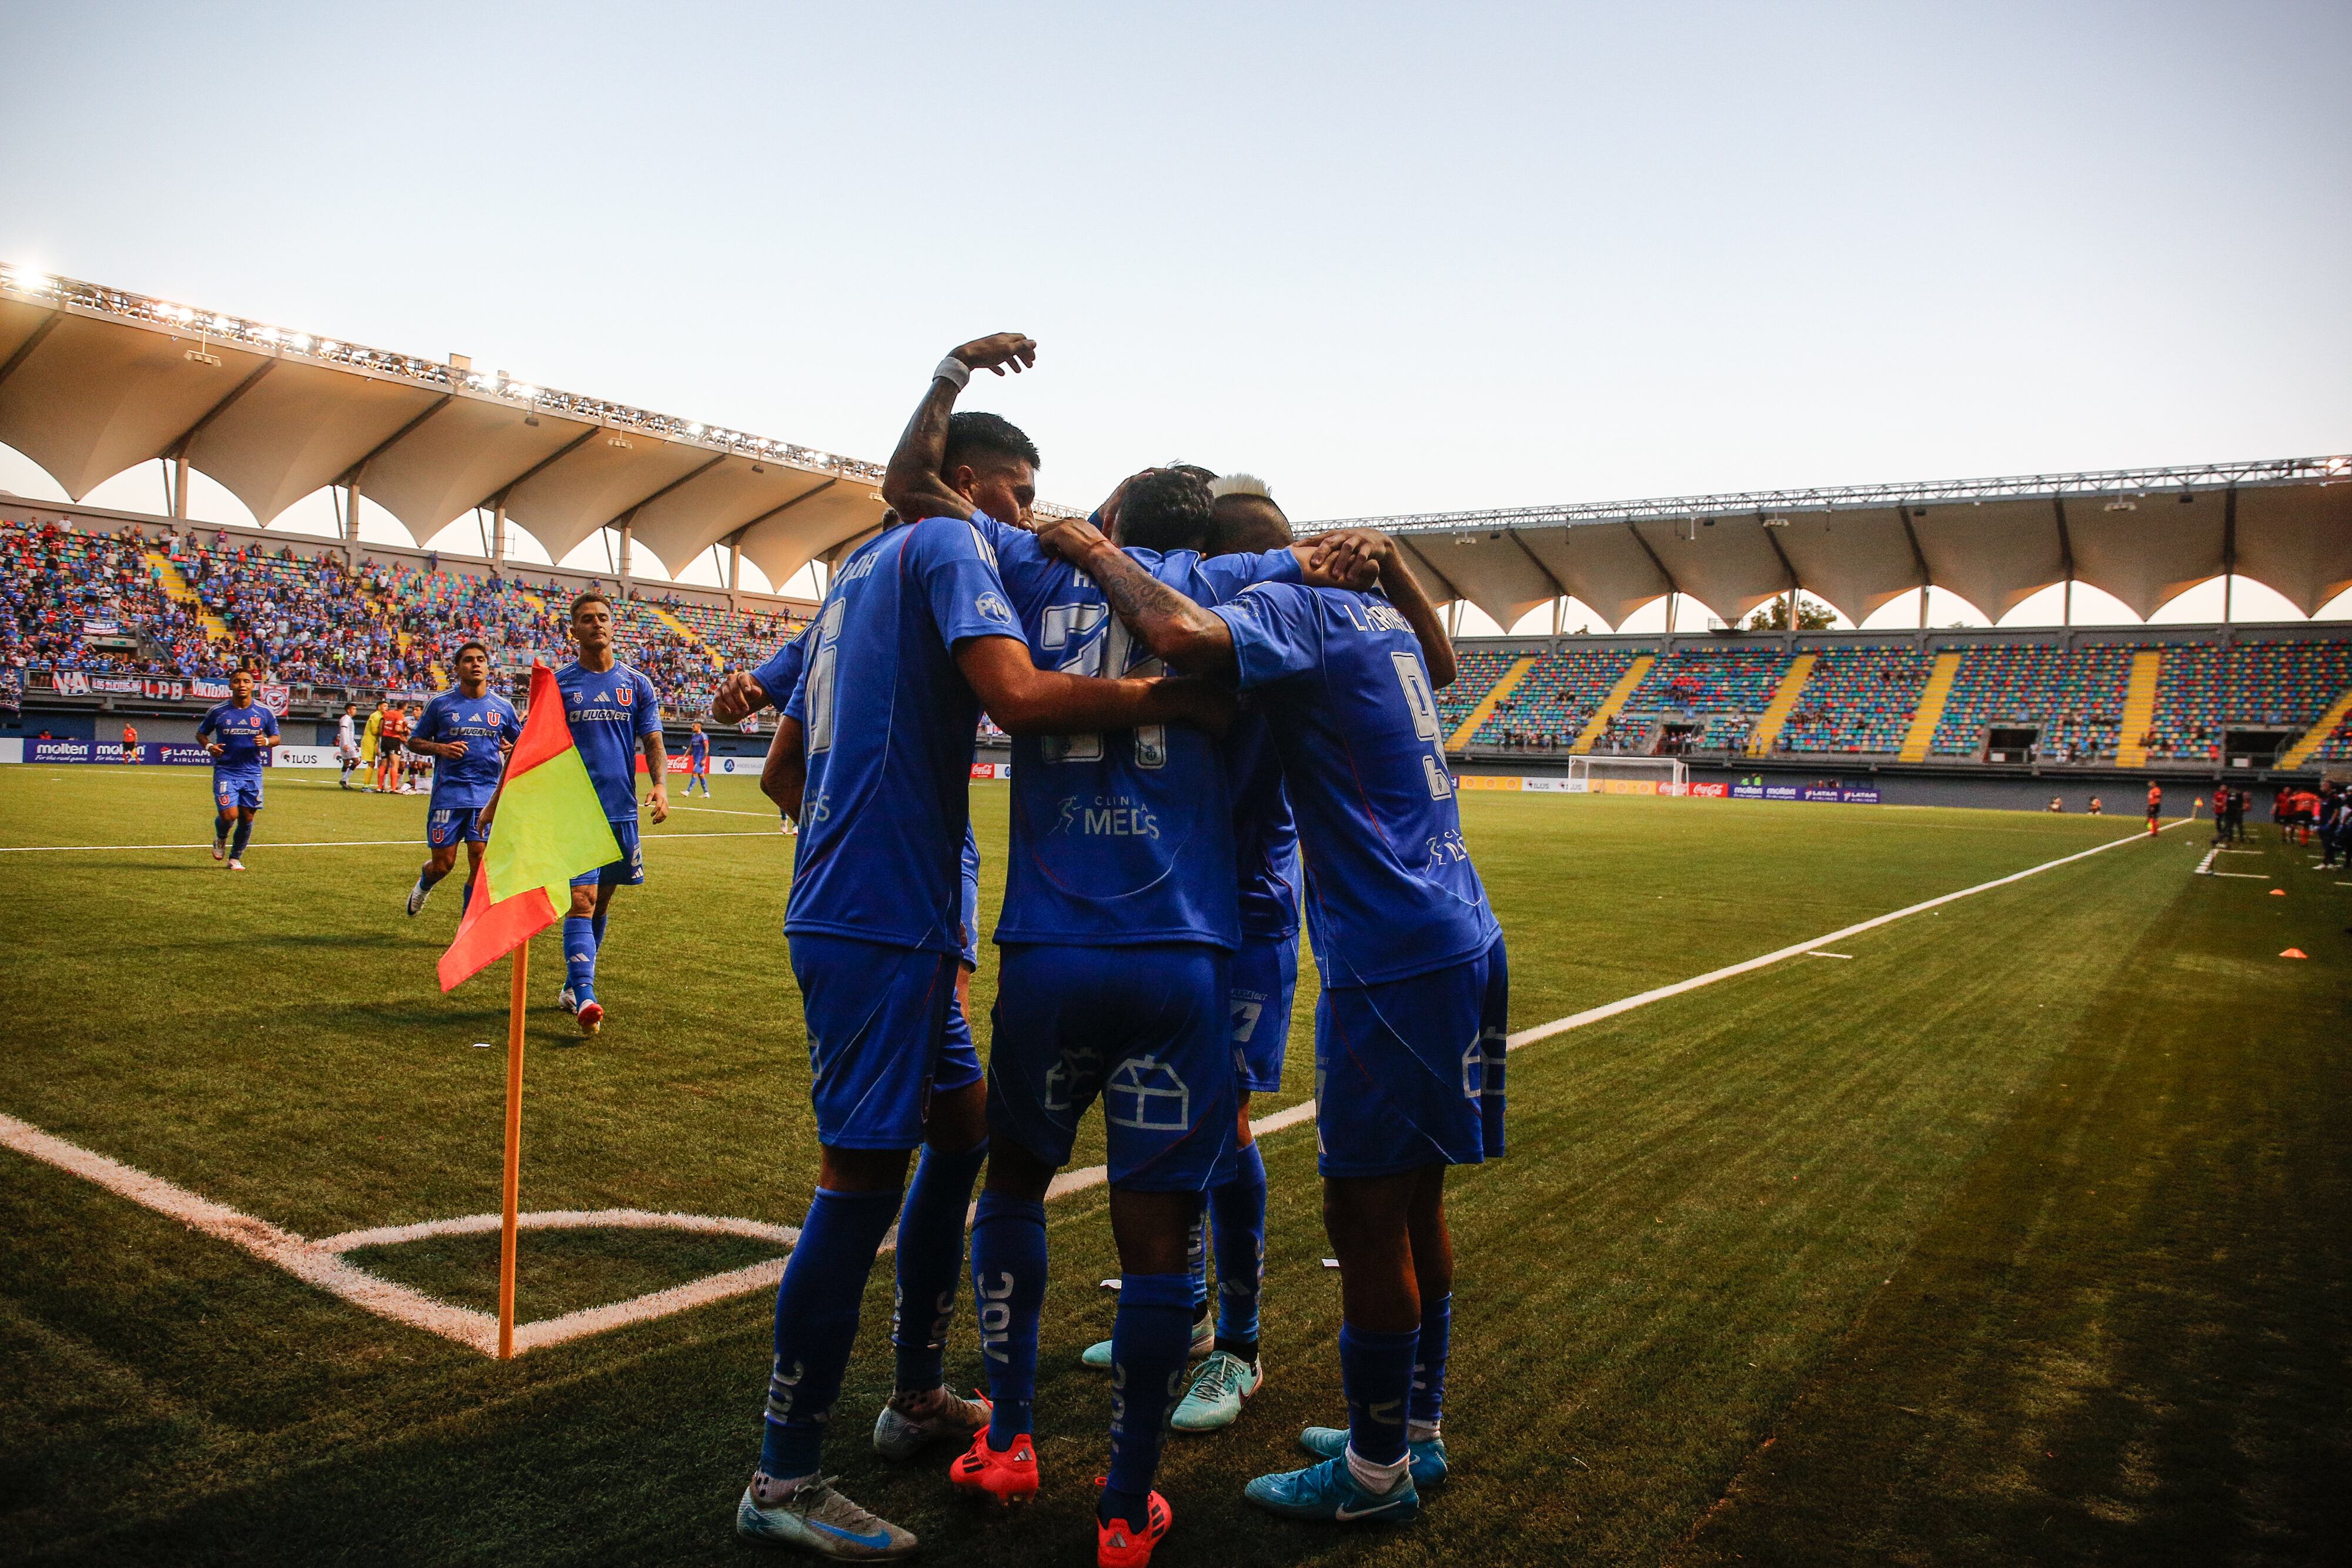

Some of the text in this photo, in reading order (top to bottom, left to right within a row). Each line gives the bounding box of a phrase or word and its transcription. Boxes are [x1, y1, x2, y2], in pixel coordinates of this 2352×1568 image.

[144, 680, 183, 700] LPB
[616, 688, 633, 707] U
[250, 717, 261, 727] U
[487, 711, 501, 727] U
[1391, 651, 1452, 801] 9
[36, 743, 88, 755] molten
[96, 744, 145, 755] moln
[173, 748, 211, 757] LATAM
[292, 755, 318, 764] ILUS
[973, 764, 993, 775] Coca-Cola
[1692, 784, 1723, 795] Coca-Cola
[1734, 786, 1763, 794] molten
[1766, 787, 1796, 796] molten
[218, 794, 230, 806] U
[1095, 796, 1148, 813] CLINA
[432, 828, 445, 843] U
